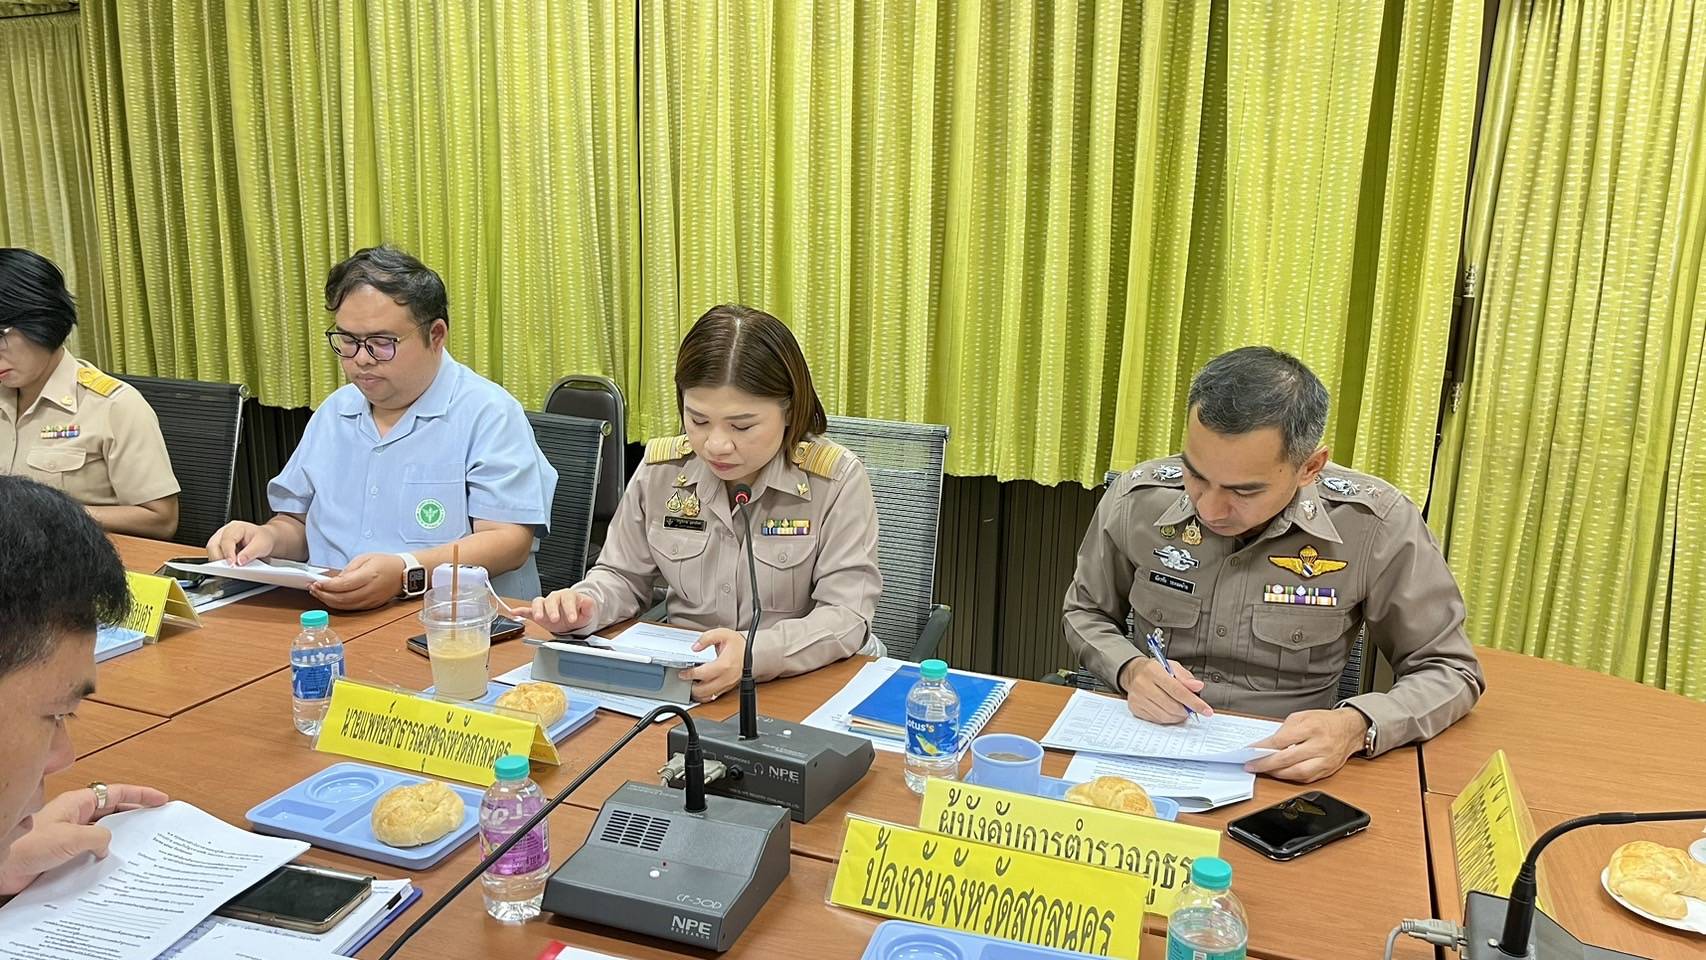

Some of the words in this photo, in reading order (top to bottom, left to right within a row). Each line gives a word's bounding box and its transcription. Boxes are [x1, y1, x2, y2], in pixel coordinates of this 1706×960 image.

[907, 719, 935, 733] otus's
[768, 765, 799, 781] NPE
[938, 787, 1192, 904] ผ้บังคับการตำรวจภูธร
[861, 827, 1115, 957] ป้องกันจังหวัดสกลนคร
[671, 914, 712, 936] NPE
